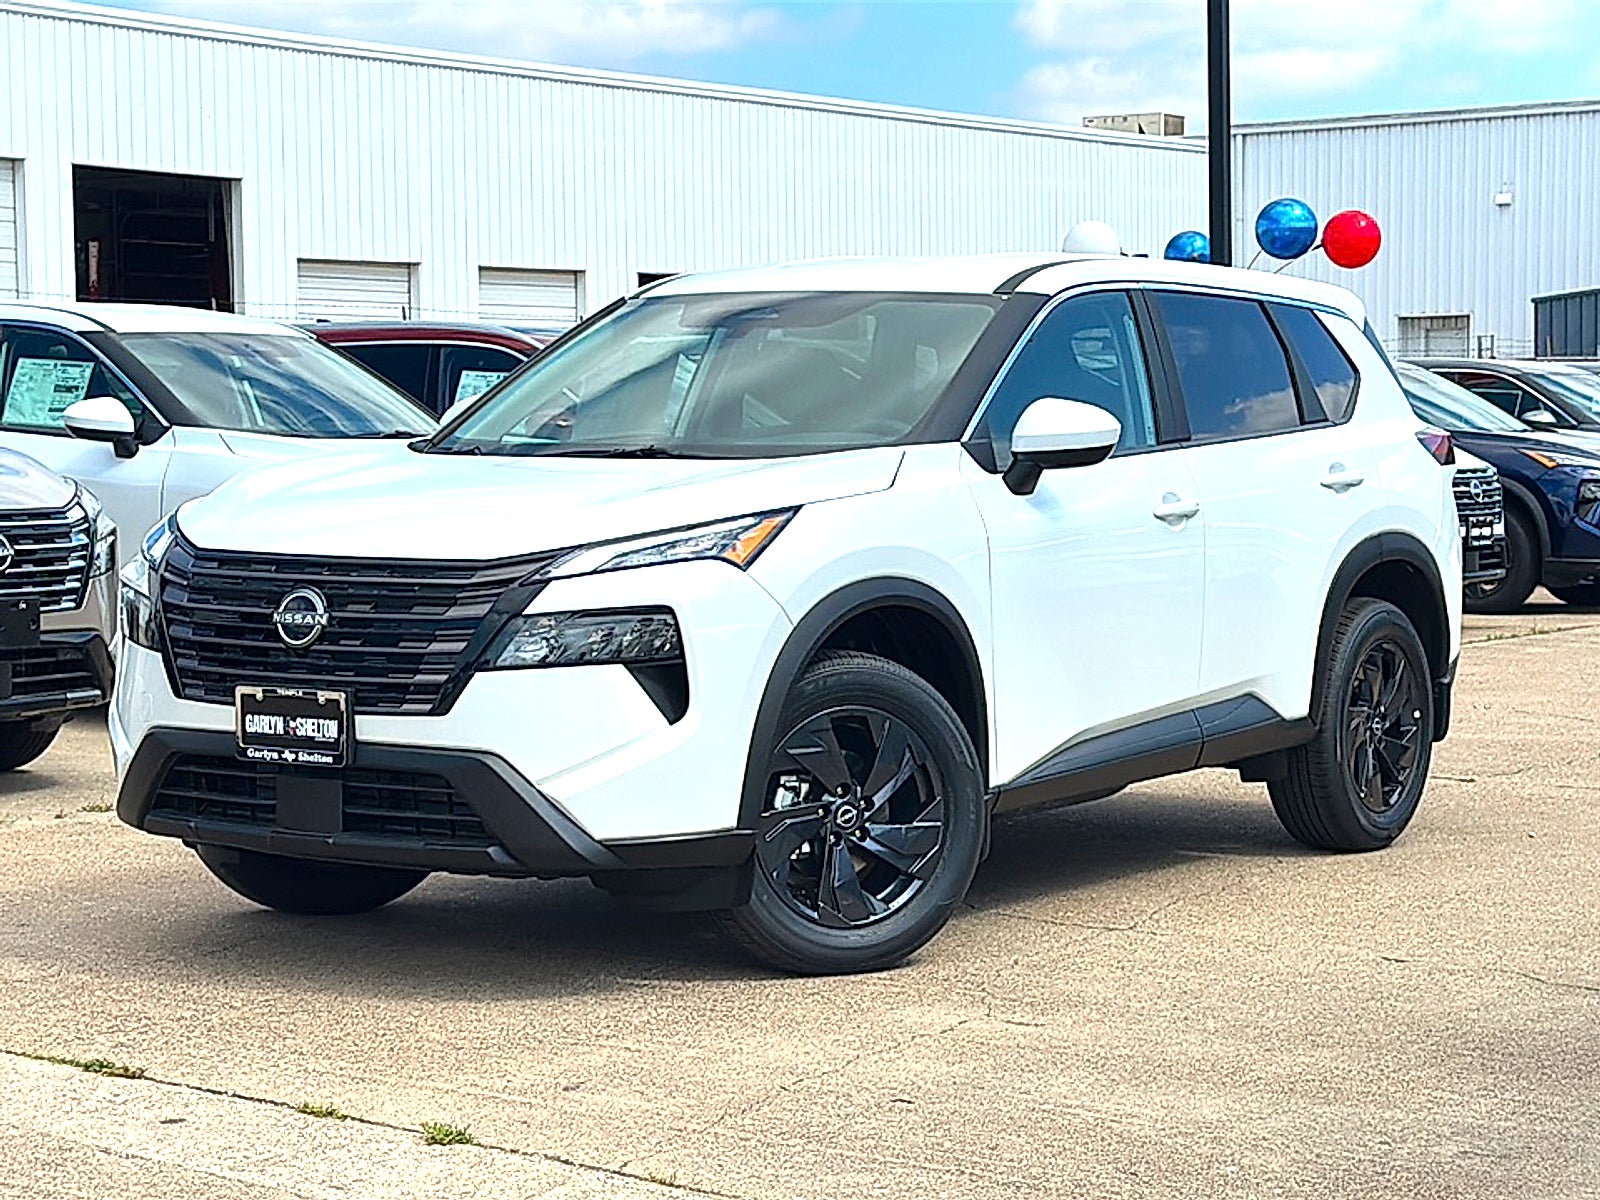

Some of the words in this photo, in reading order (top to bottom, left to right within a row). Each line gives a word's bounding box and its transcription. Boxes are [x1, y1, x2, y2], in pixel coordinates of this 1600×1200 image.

[273, 612, 329, 625] NISSAN
[245, 714, 284, 735] GARLYN
[296, 717, 338, 739] SHELTON
[247, 748, 279, 761] Garlyn
[298, 752, 333, 763] Shelton
